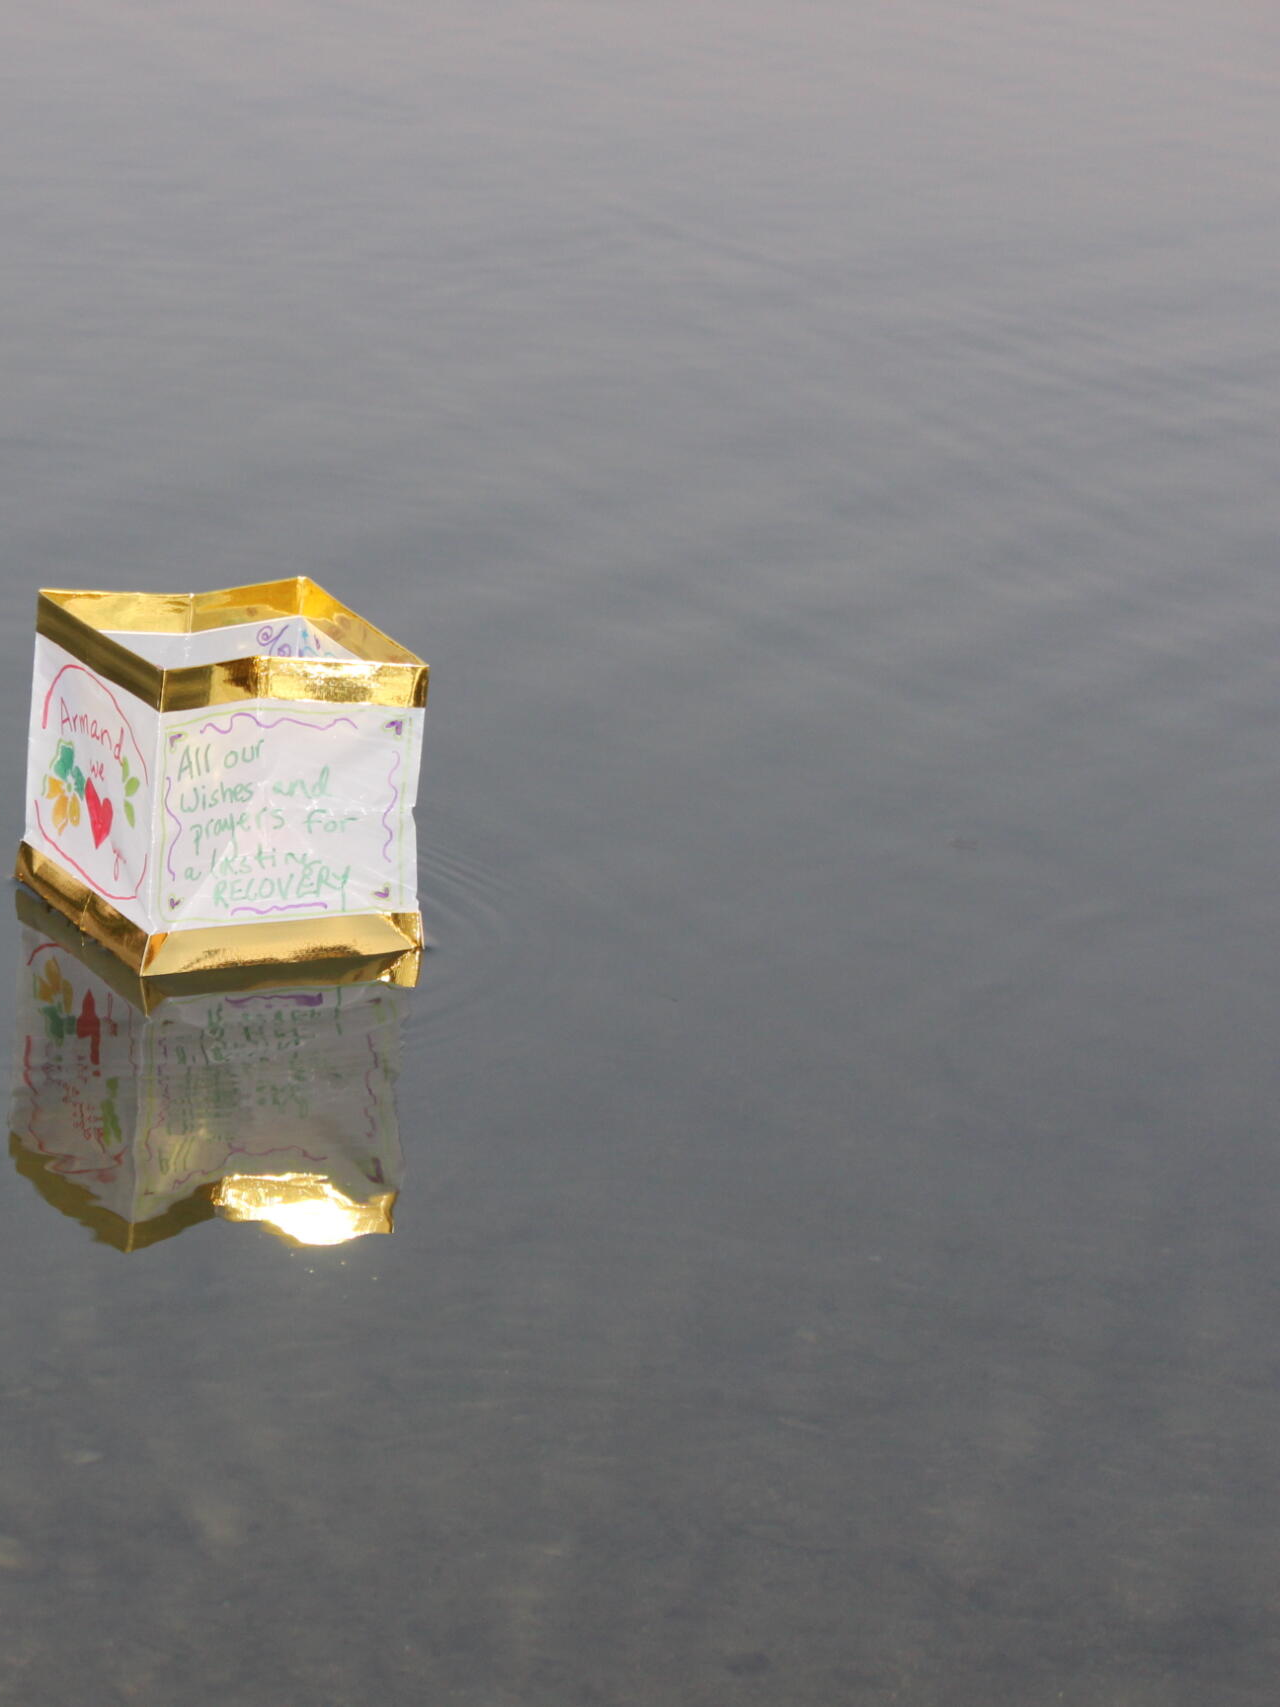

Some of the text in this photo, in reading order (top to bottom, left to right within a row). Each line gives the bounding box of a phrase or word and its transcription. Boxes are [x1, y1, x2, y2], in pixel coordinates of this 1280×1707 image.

[60, 697, 125, 767] Armand
[177, 738, 265, 782] All our
[272, 765, 331, 799] and
[189, 807, 285, 857] prayers
[184, 866, 202, 882] a
